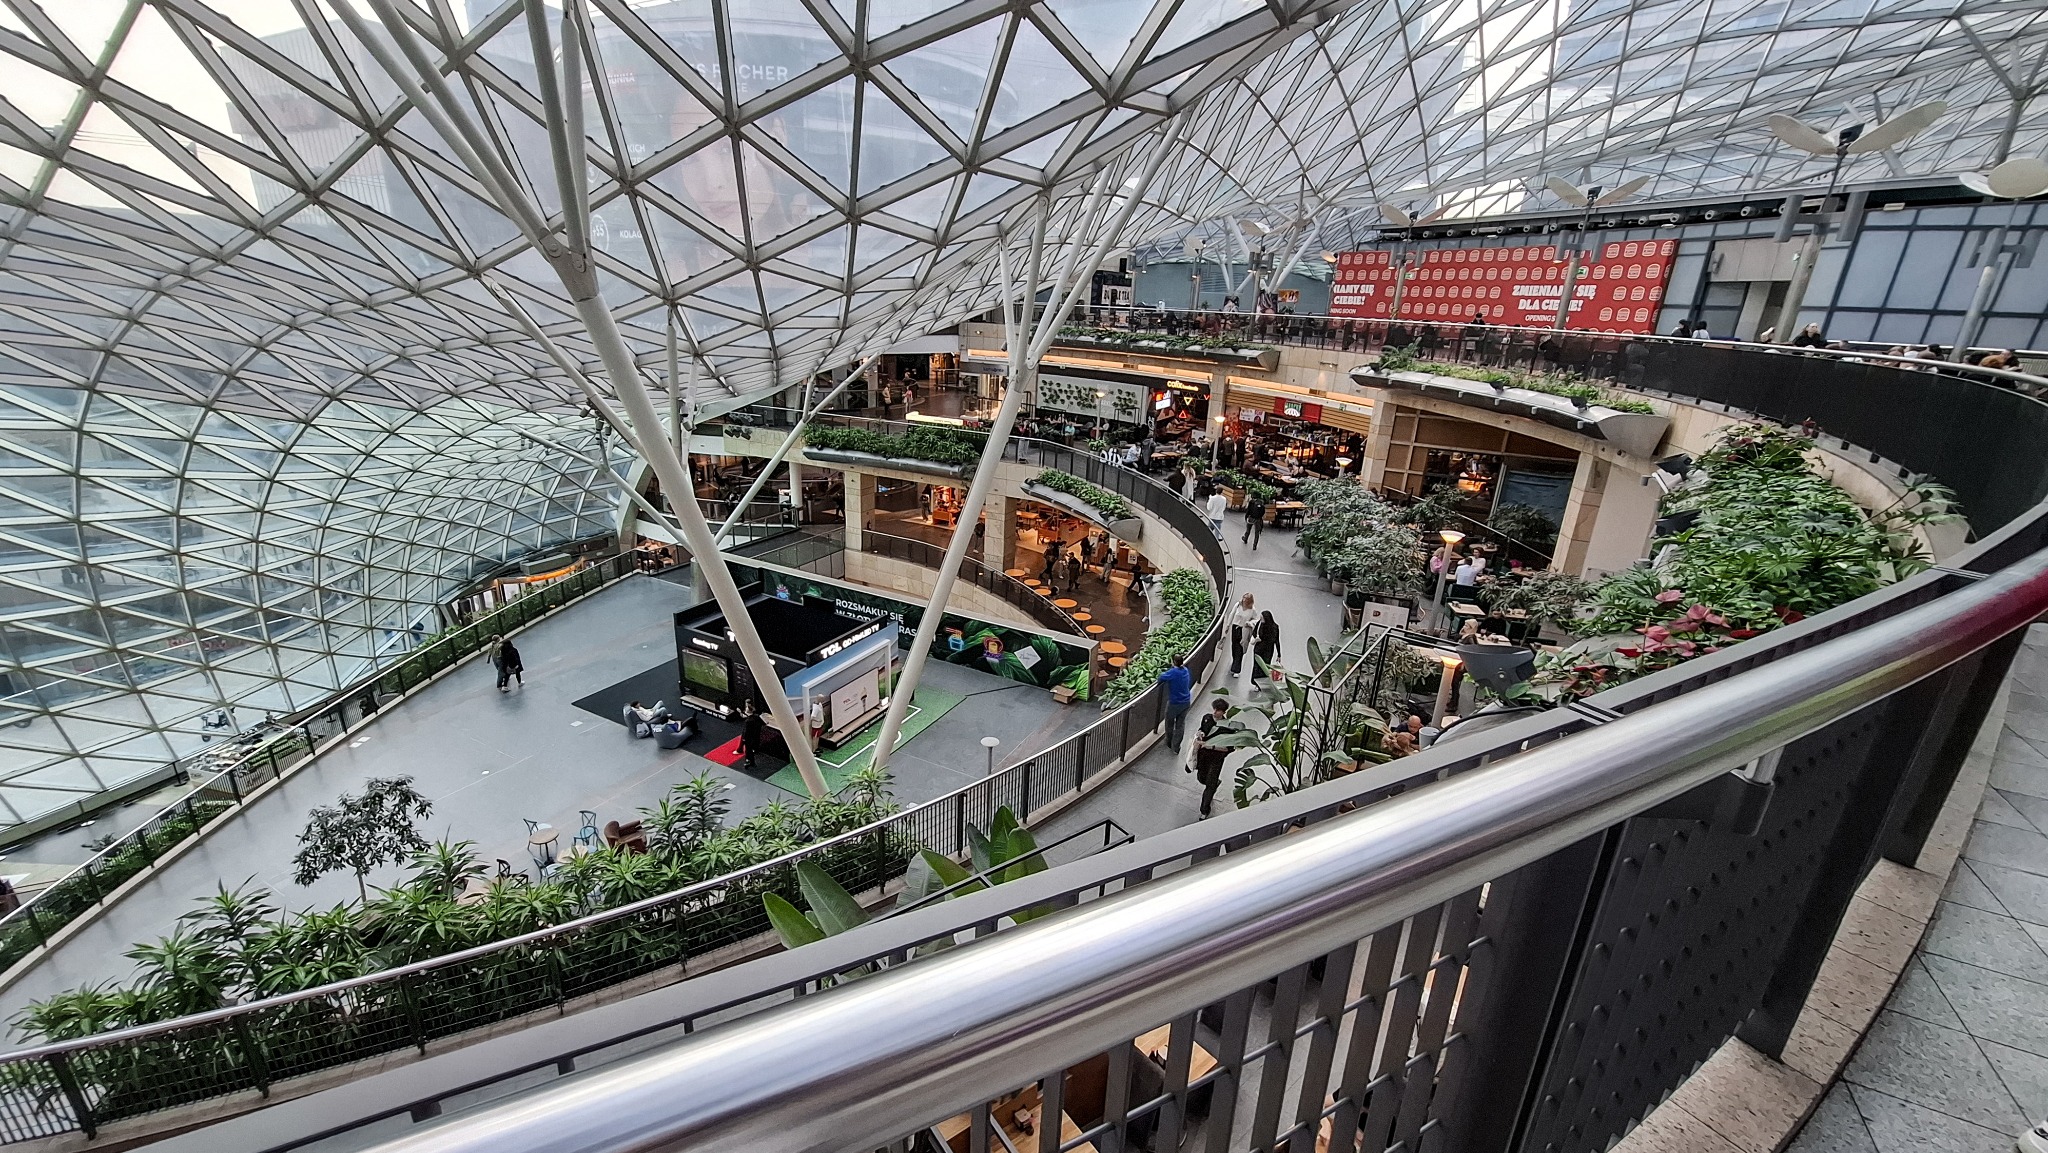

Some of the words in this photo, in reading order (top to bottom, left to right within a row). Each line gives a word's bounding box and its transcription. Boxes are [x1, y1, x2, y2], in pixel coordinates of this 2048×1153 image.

[712, 64, 788, 81] RCHER
[1576, 285, 1597, 300] SIĘ
[1517, 299, 1540, 310] DLA
[1541, 300, 1584, 312] CIEIE!
[820, 642, 843, 659] TCL
